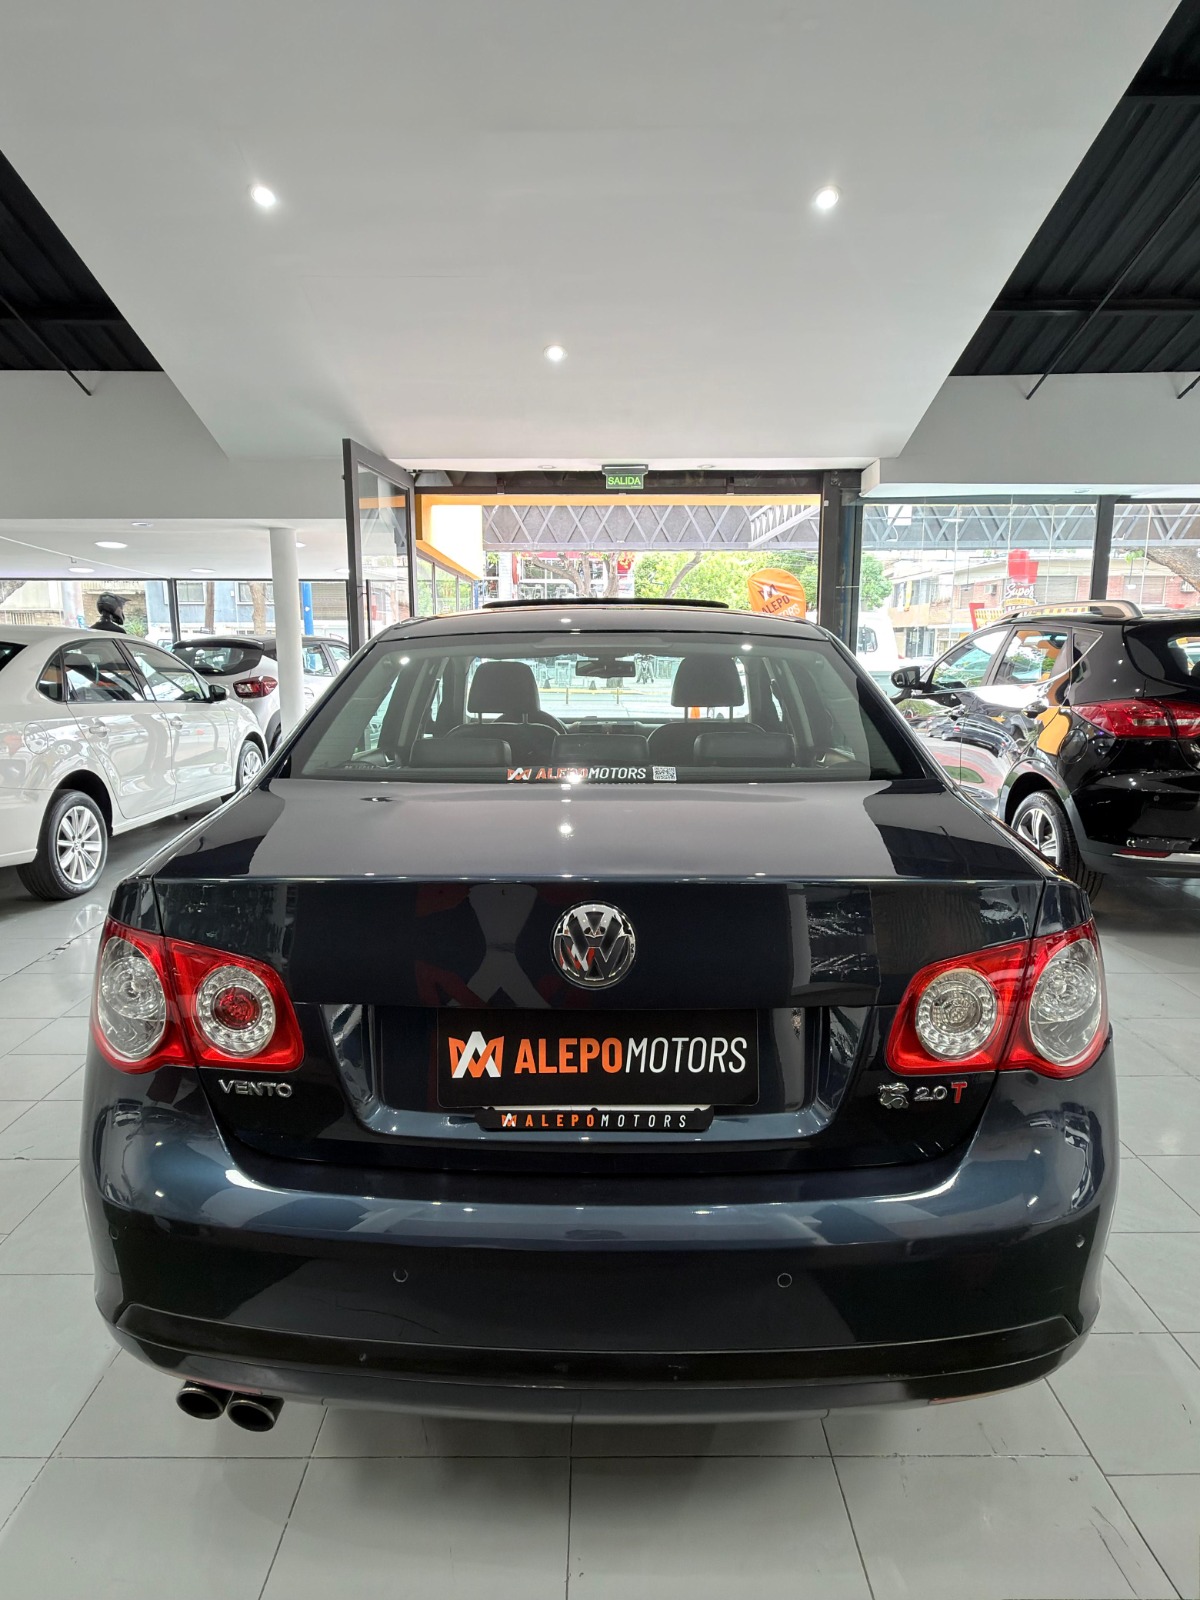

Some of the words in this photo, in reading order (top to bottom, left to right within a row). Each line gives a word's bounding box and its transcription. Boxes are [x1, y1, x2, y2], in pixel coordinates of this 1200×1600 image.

[608, 476, 641, 485] SALIDA
[761, 595, 790, 614] ALEPO
[218, 1079, 293, 1098] VENTO
